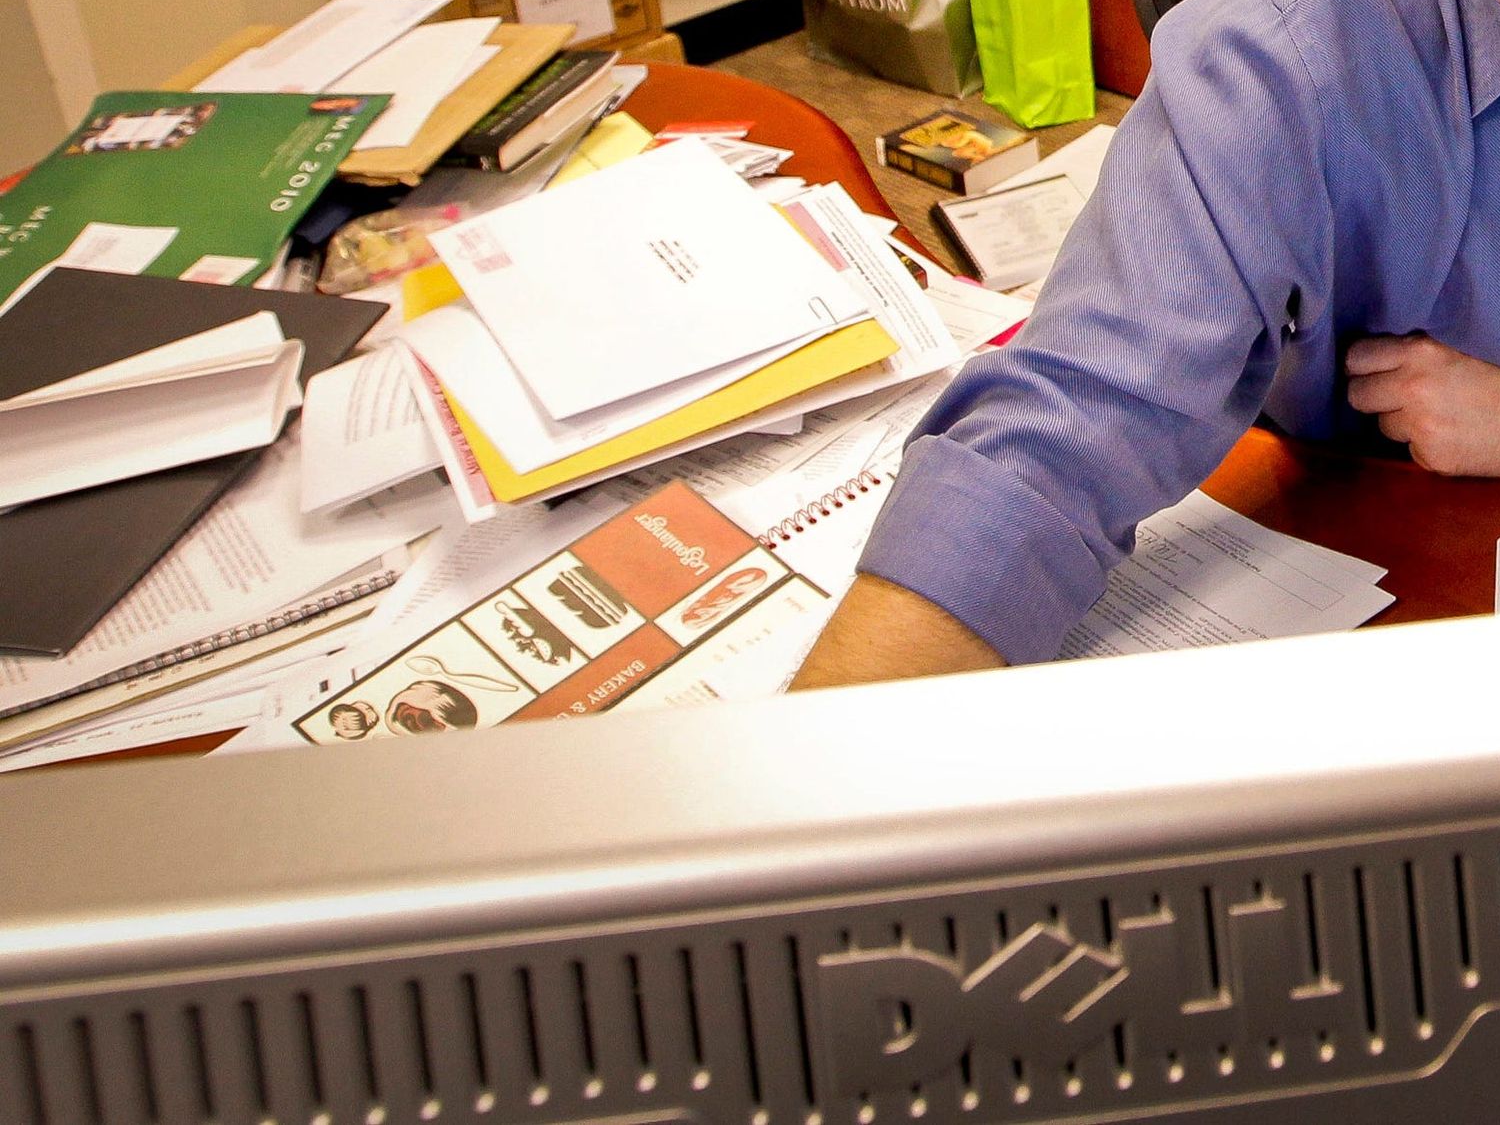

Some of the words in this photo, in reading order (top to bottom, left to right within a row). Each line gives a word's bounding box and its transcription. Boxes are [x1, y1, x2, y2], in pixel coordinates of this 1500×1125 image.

[269, 160, 321, 213] 2010
[587, 659, 646, 705] BAKERY
[569, 701, 587, 713] &
[815, 895, 1345, 1095] DELL
